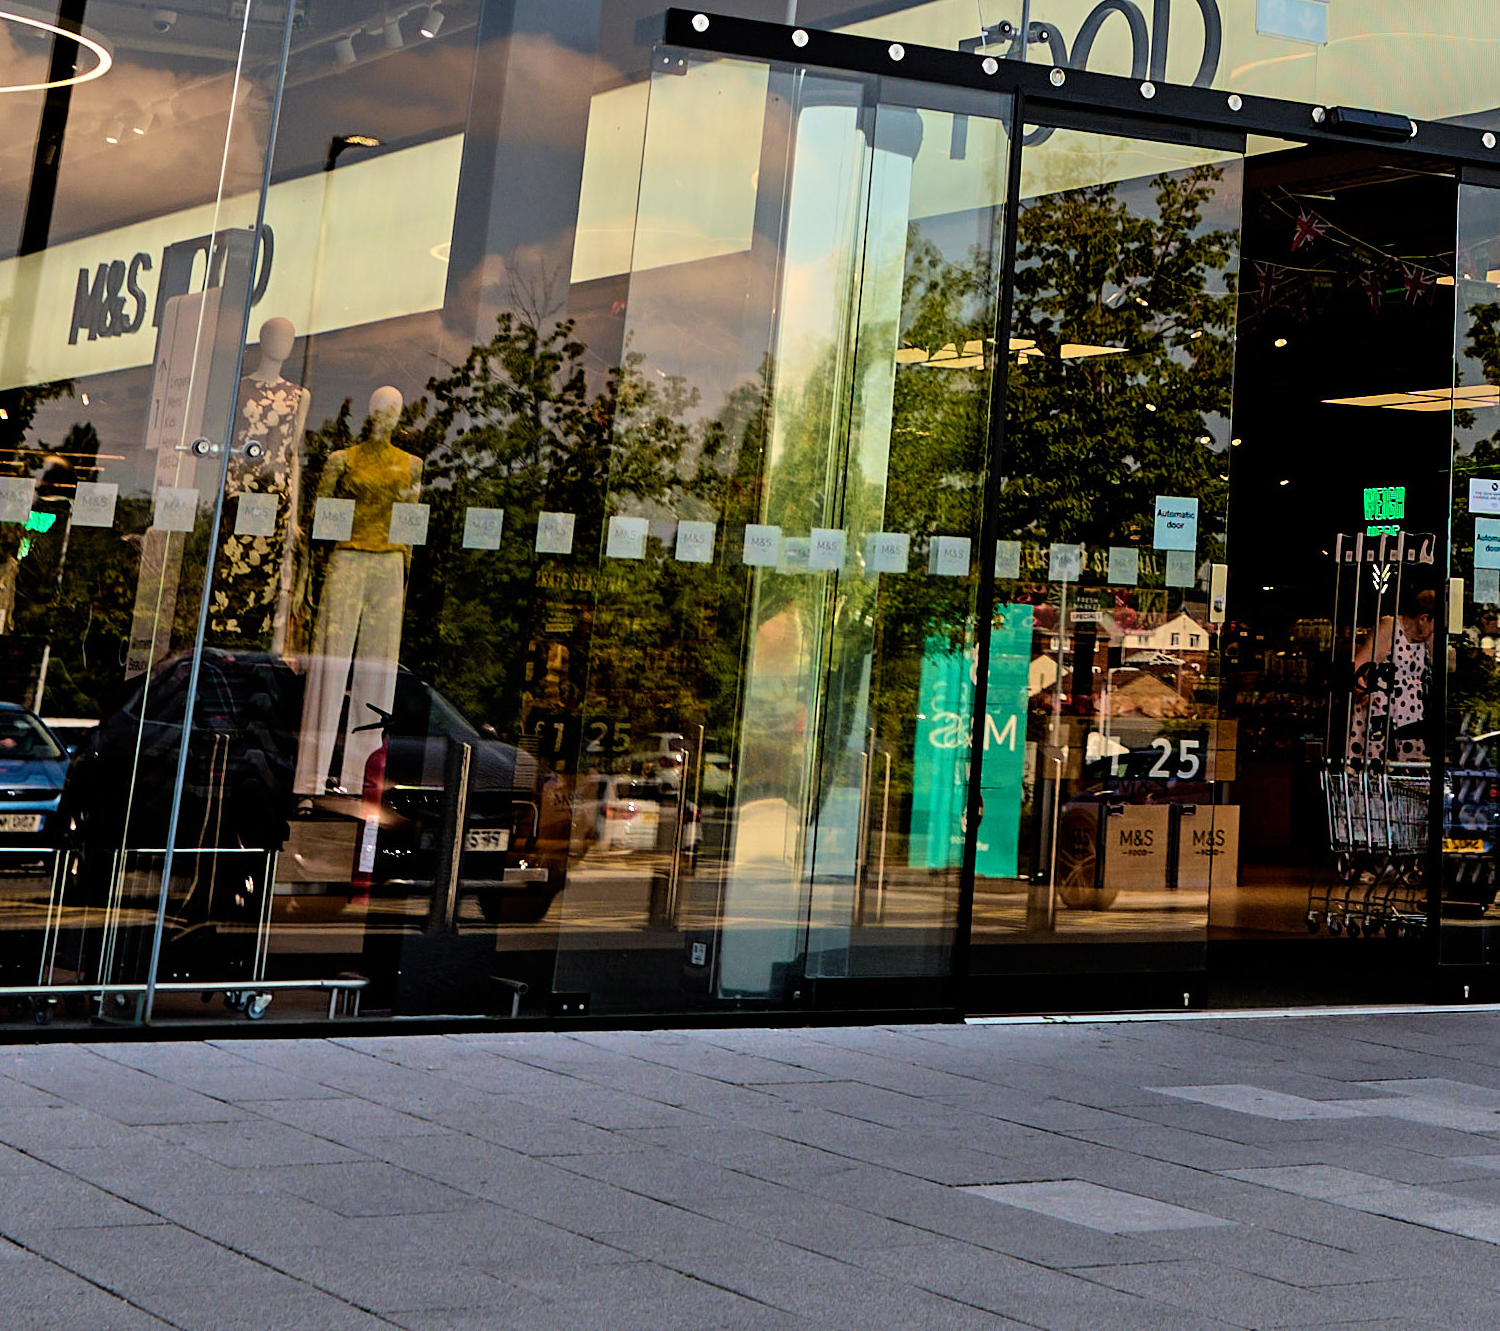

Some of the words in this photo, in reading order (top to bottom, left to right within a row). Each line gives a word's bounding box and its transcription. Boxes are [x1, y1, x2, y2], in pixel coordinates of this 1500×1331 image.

[68, 252, 153, 345] M&S
[81, 495, 108, 508] M&S
[1157, 508, 1195, 520] Automatic
[1166, 520, 1185, 530] door
[750, 537, 772, 547] M&S
[817, 540, 838, 551] M&S
[881, 544, 901, 555] M&S
[944, 549, 964, 559] M&S
[1485, 544, 1500, 553] door
[587, 721, 632, 752] 25
[1148, 737, 1201, 780] 25
[1119, 829, 1154, 847] M&S
[1192, 829, 1226, 847] M&S
